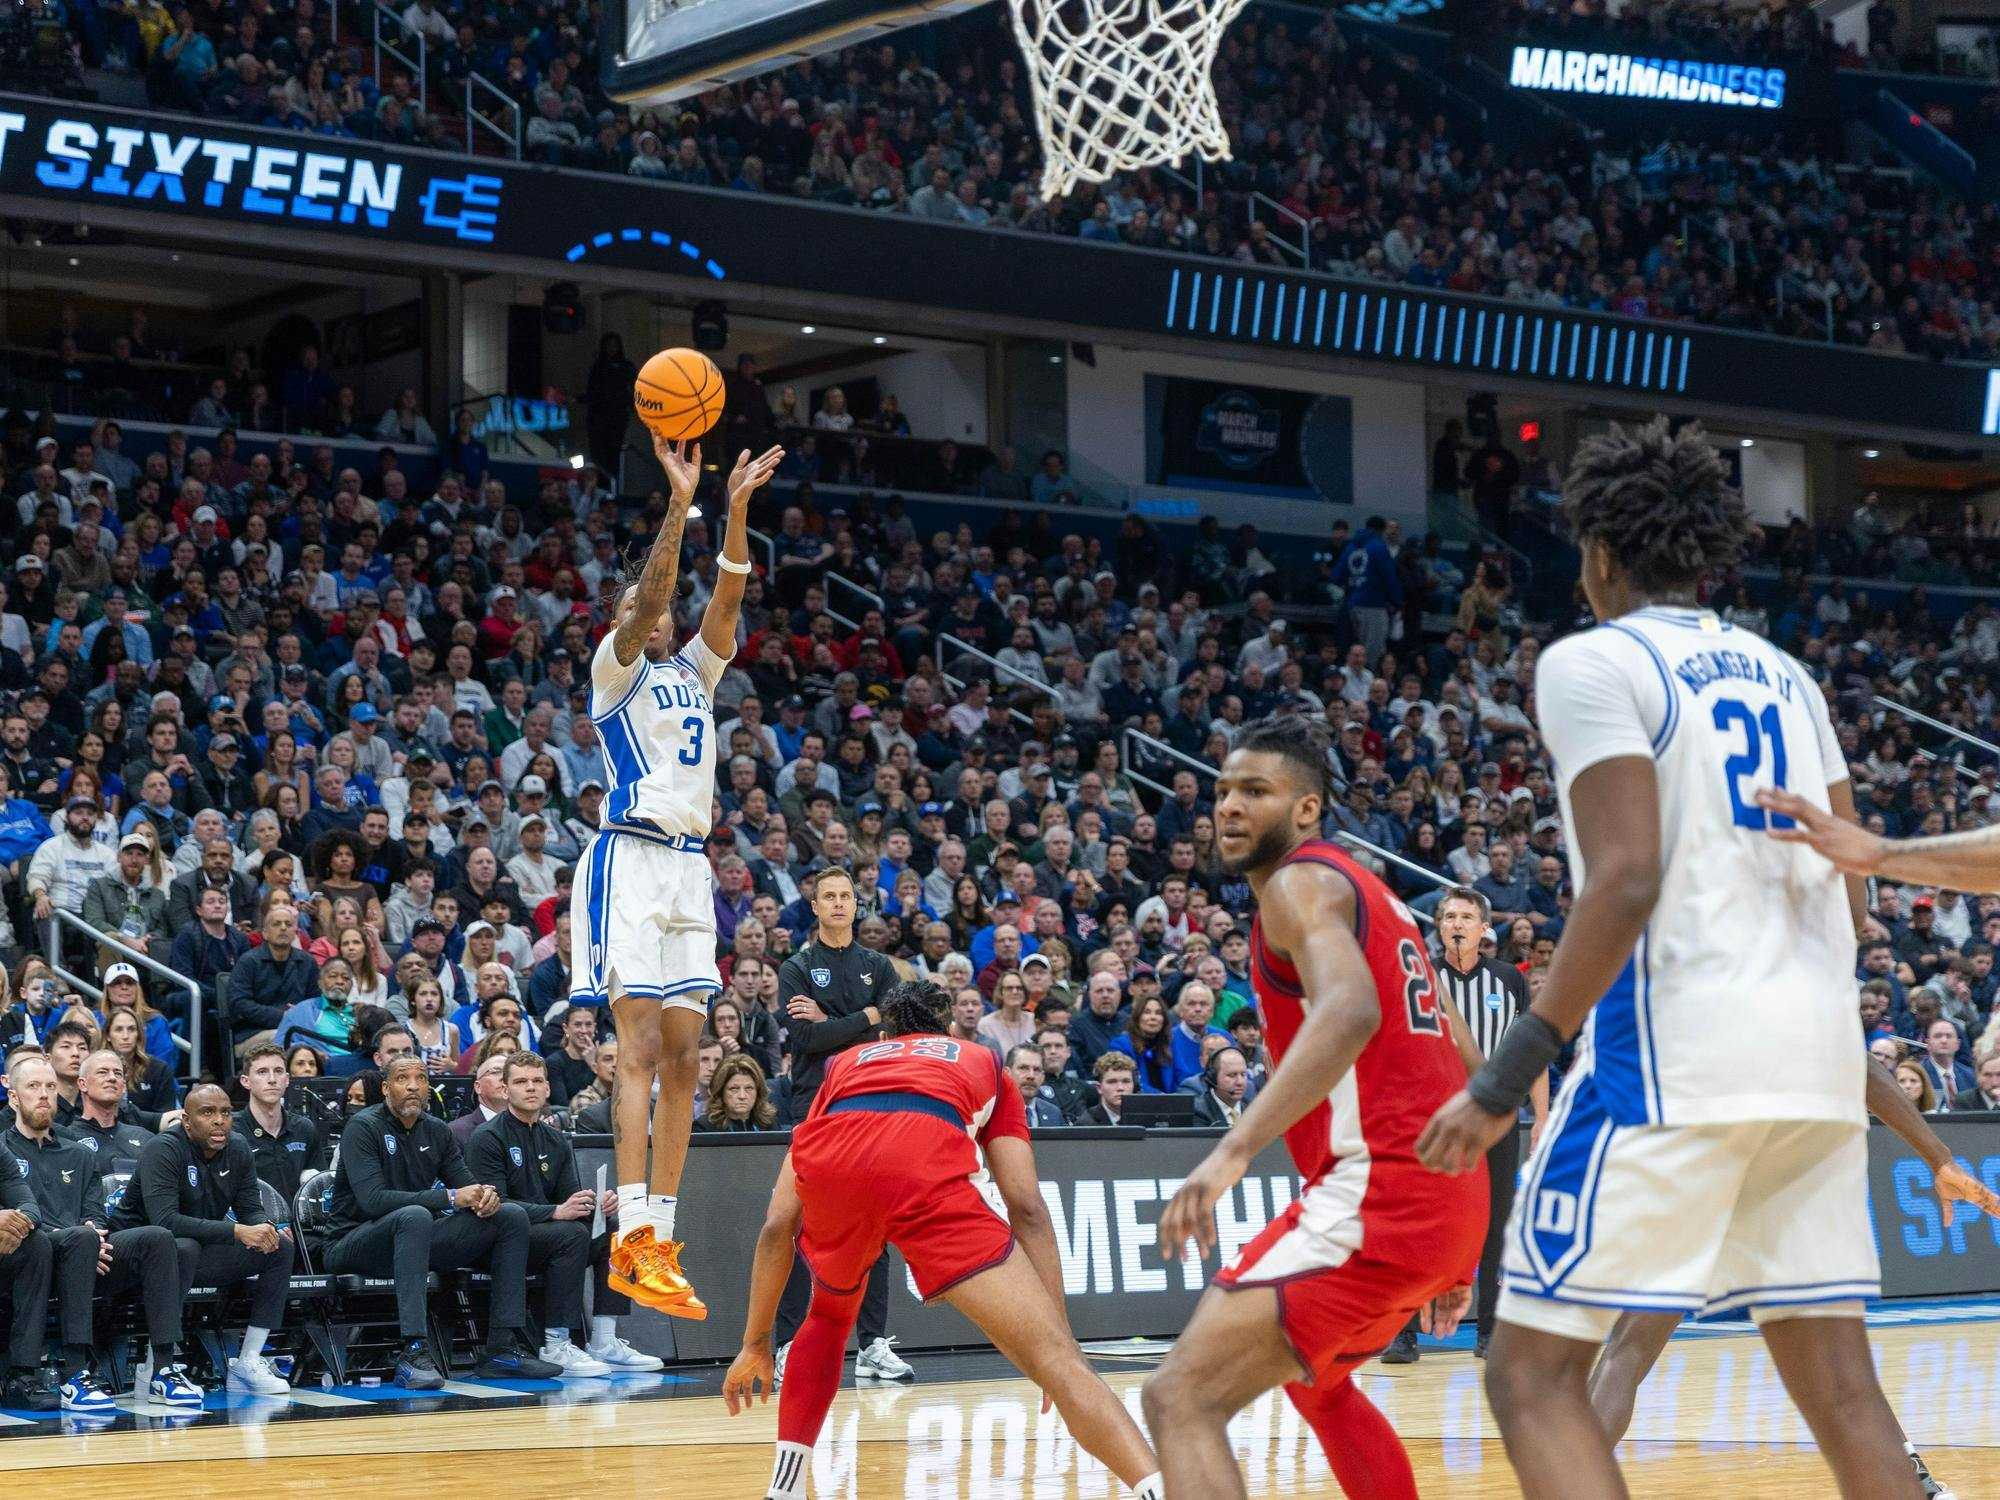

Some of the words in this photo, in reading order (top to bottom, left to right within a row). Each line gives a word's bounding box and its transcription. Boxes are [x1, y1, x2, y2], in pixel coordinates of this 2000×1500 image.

[35, 118, 403, 229] SIXTEEN
[678, 716, 705, 767] 3
[1712, 698, 1797, 832] 21
[1397, 937, 1450, 1037] 2
[856, 1040, 961, 1067] 23
[1534, 1188, 1578, 1236] D
